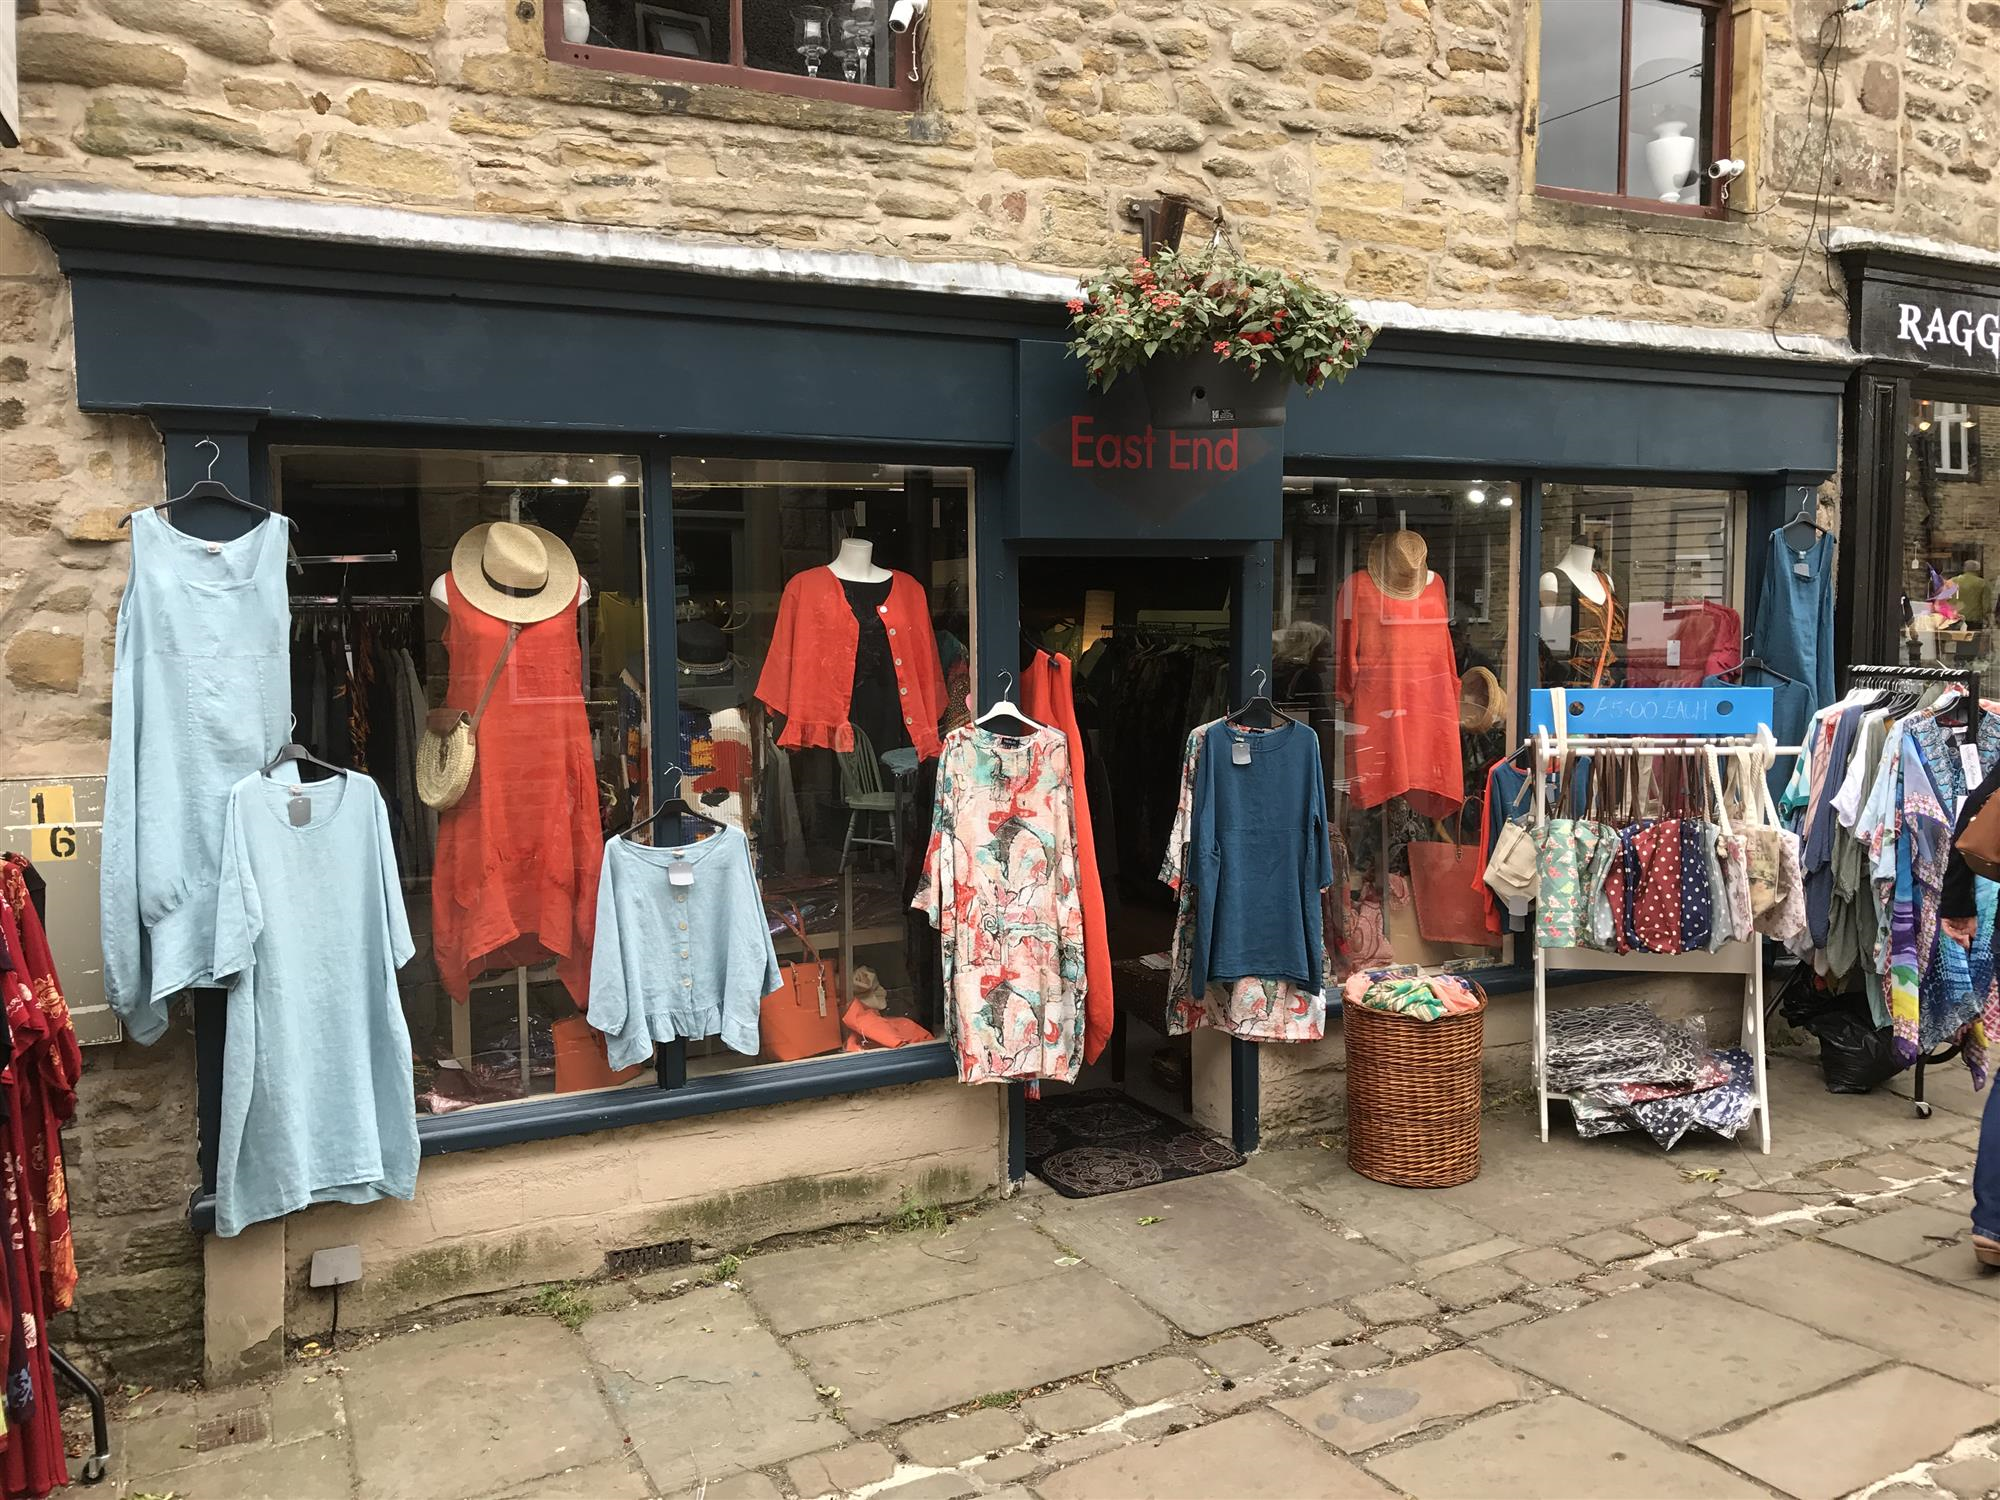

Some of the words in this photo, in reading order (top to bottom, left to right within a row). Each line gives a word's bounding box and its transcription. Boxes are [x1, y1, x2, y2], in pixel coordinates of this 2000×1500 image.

[1897, 303, 2000, 360] RAGG
[1072, 415, 1157, 469] East
[1168, 428, 1239, 471] End
[1661, 700, 1708, 720] EACH
[32, 792, 45, 824] 1
[50, 826, 76, 857] 6
